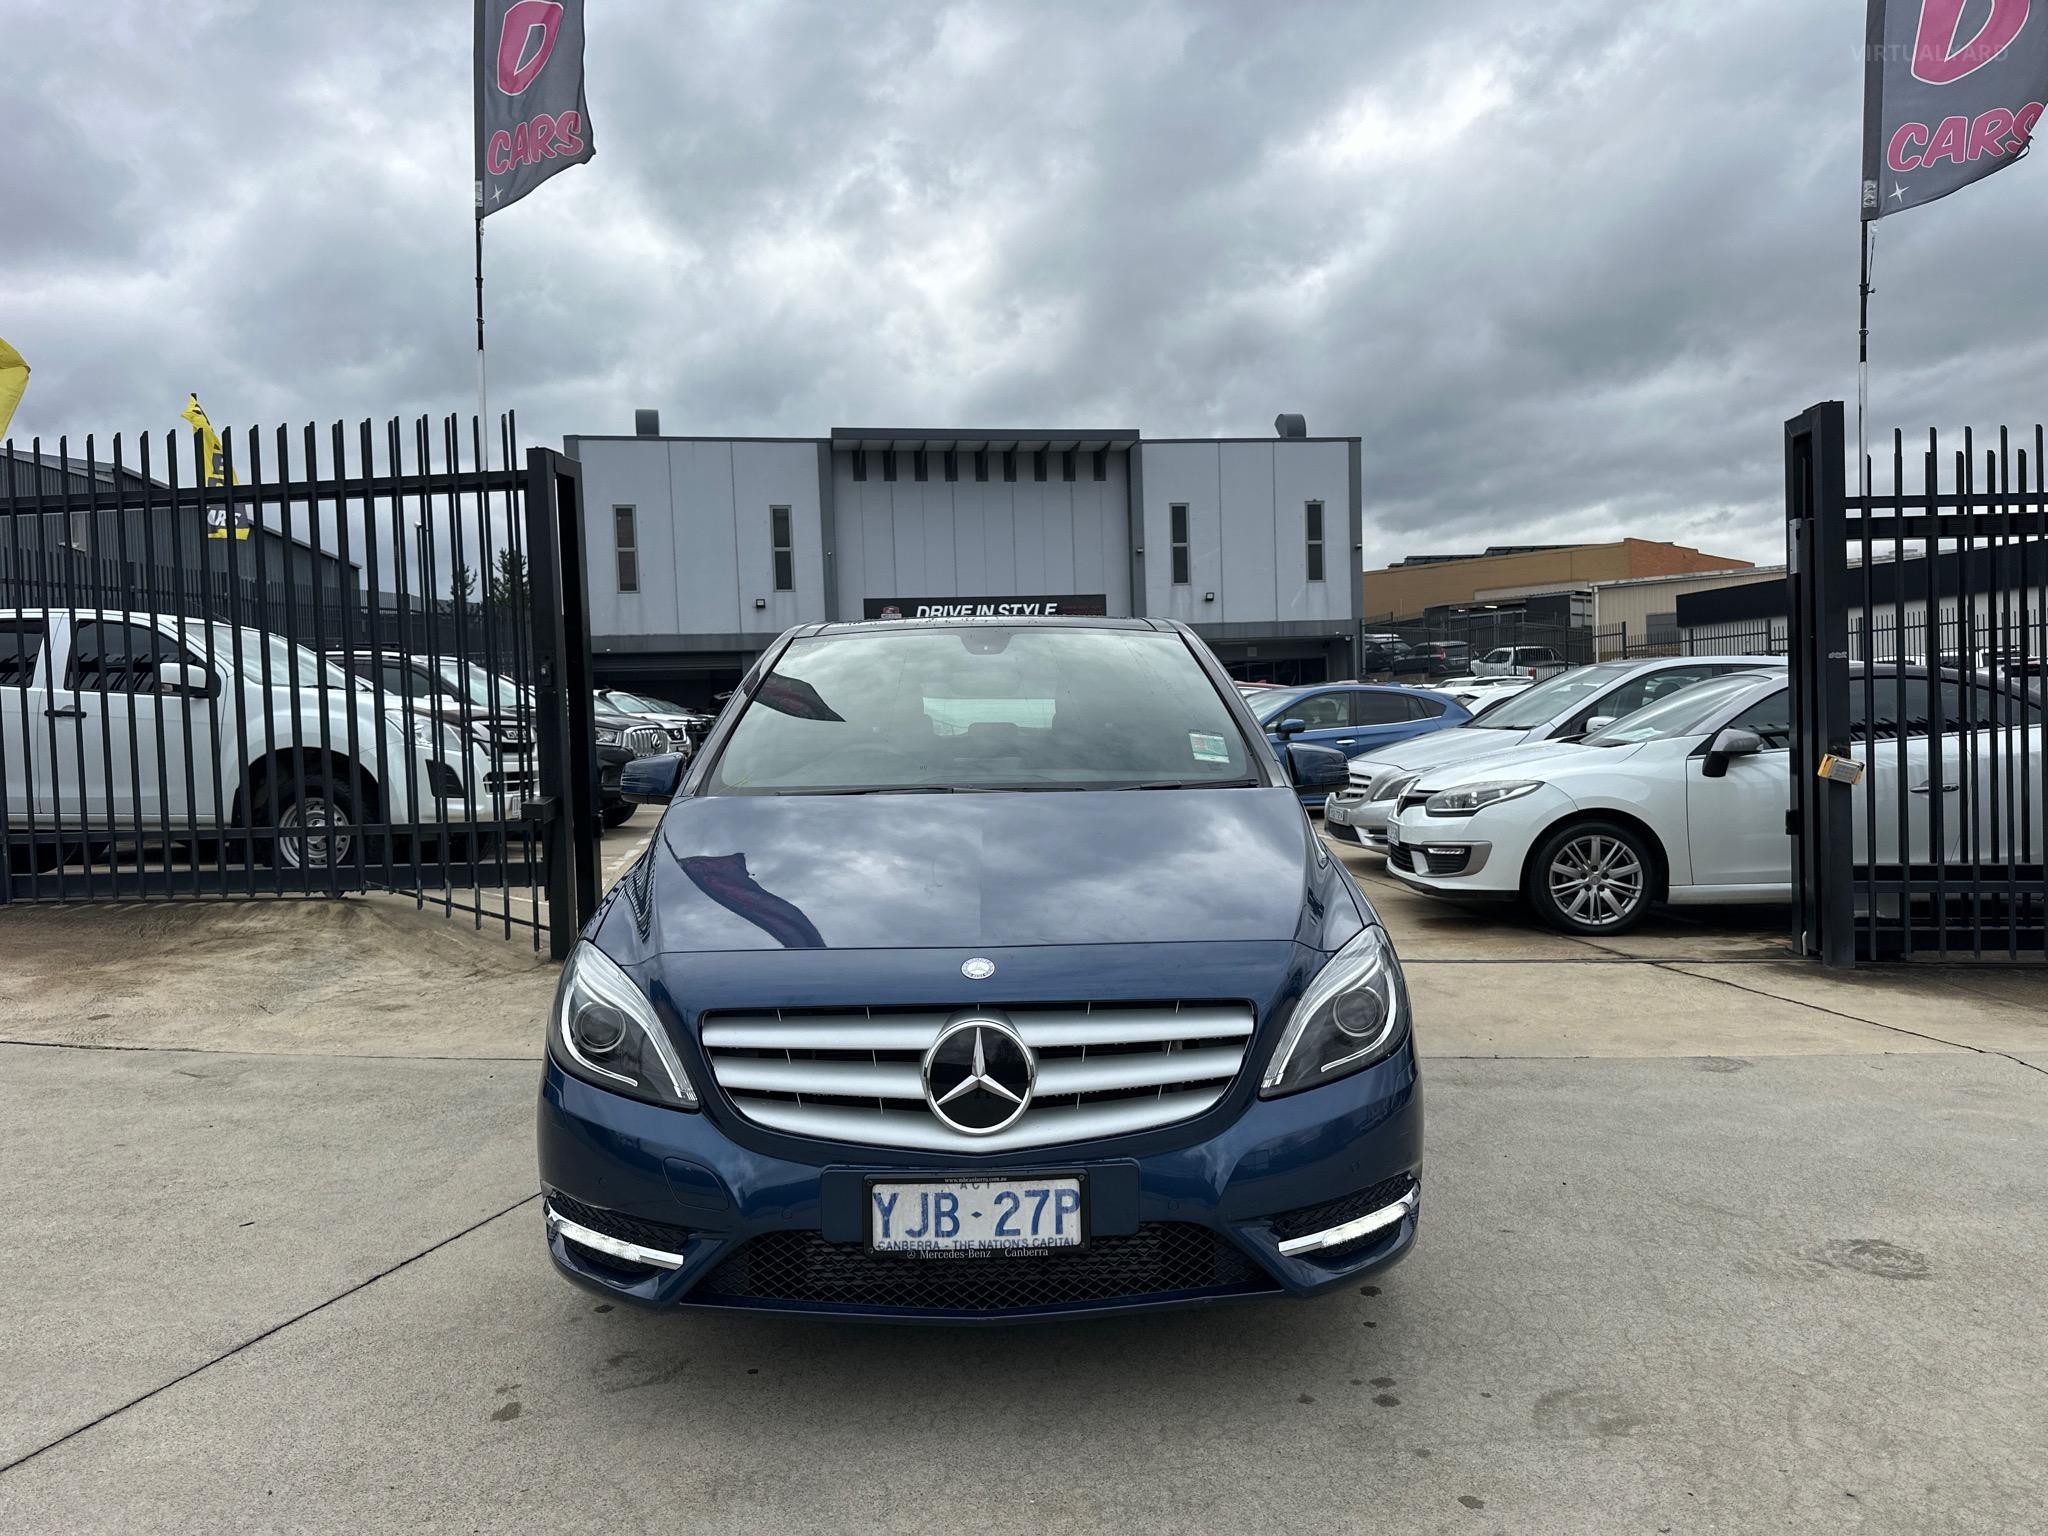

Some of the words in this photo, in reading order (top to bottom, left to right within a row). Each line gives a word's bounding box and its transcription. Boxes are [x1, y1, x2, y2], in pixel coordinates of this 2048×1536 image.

[497, 0, 564, 95] D
[487, 111, 583, 175] CARS
[1887, 102, 2044, 172] CARS
[916, 605, 973, 617] DRIVE
[976, 604, 995, 616] IN
[998, 603, 1057, 616] STYLE
[877, 1240, 939, 1251] CANBERRA
[953, 1239, 976, 1250] THE
[920, 1248, 991, 1259] Mercedes-Benz
[1005, 1247, 1048, 1257] Canberra
